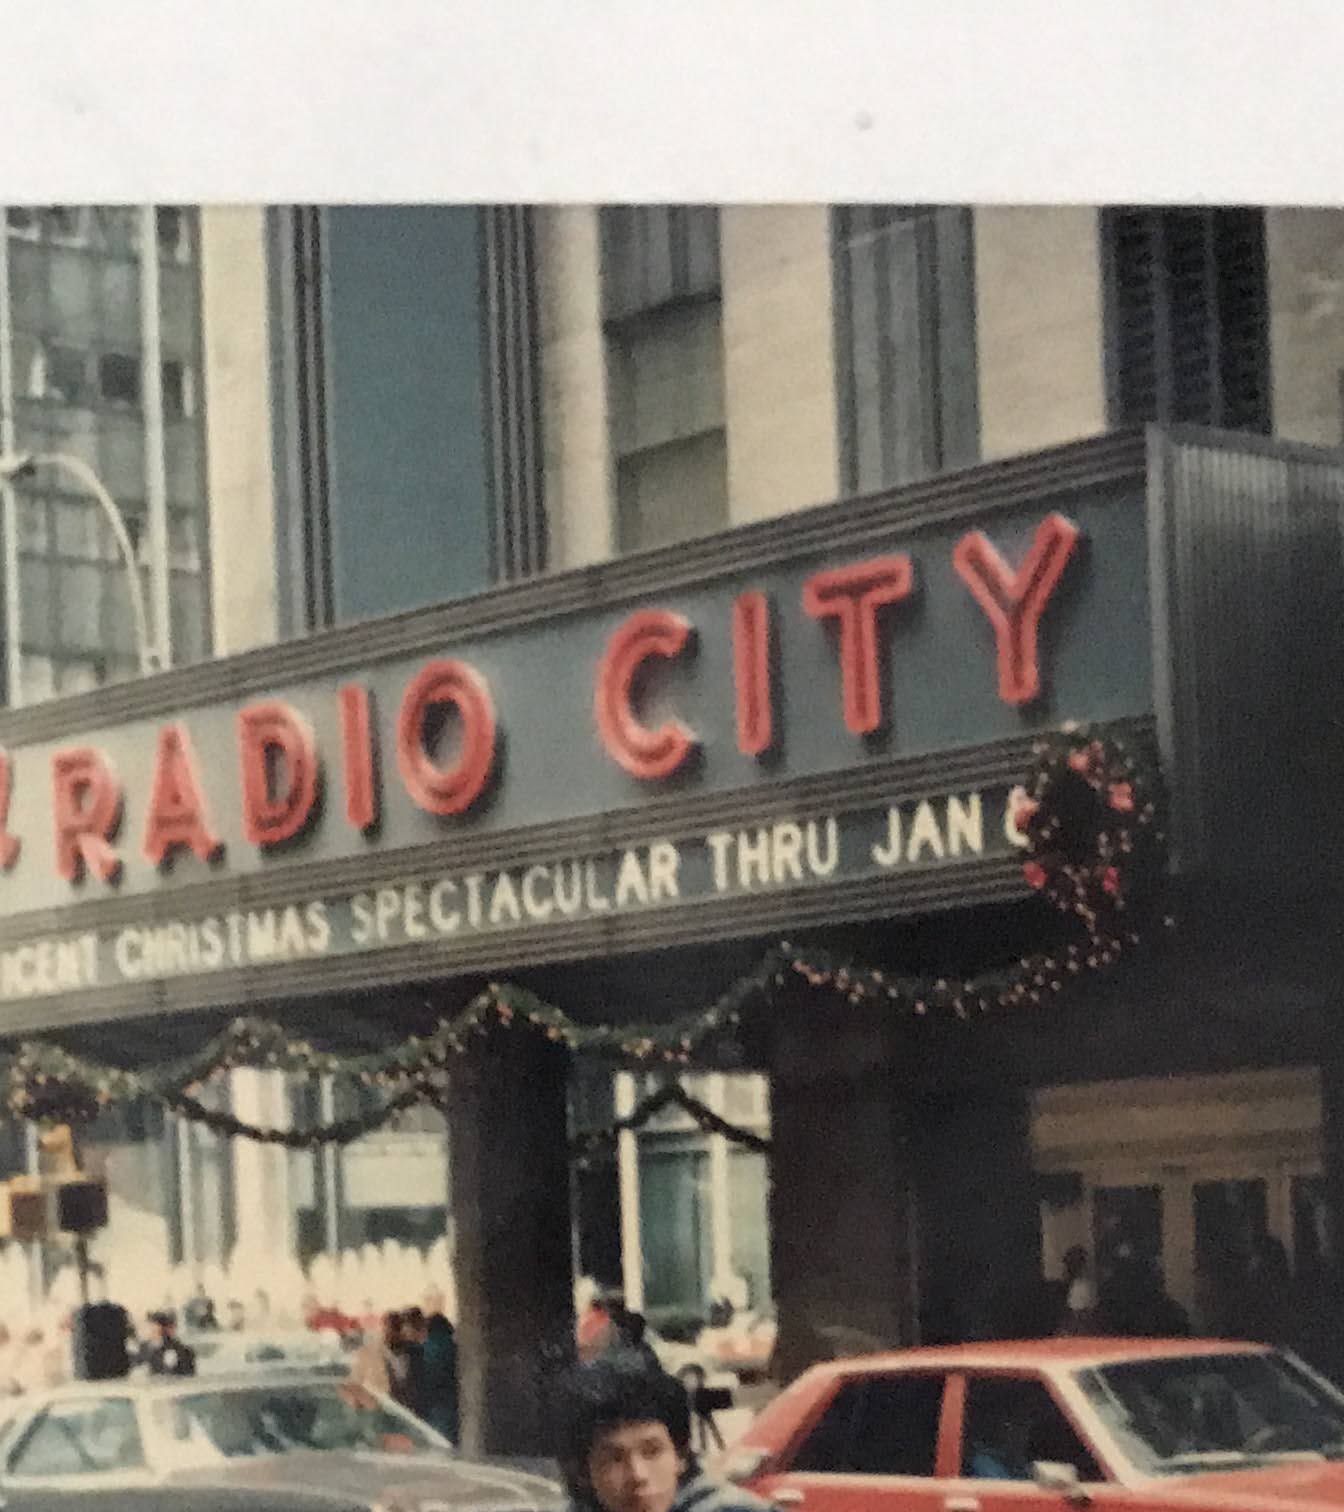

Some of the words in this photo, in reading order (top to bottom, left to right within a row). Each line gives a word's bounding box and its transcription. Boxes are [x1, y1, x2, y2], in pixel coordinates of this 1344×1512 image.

[51, 658, 498, 882] RADIO
[594, 511, 1078, 778] CITY
[115, 900, 332, 980] CHRISTMAS
[350, 840, 681, 944] SPECTACULAR
[707, 816, 839, 892] THRU
[870, 792, 984, 866] JAN
